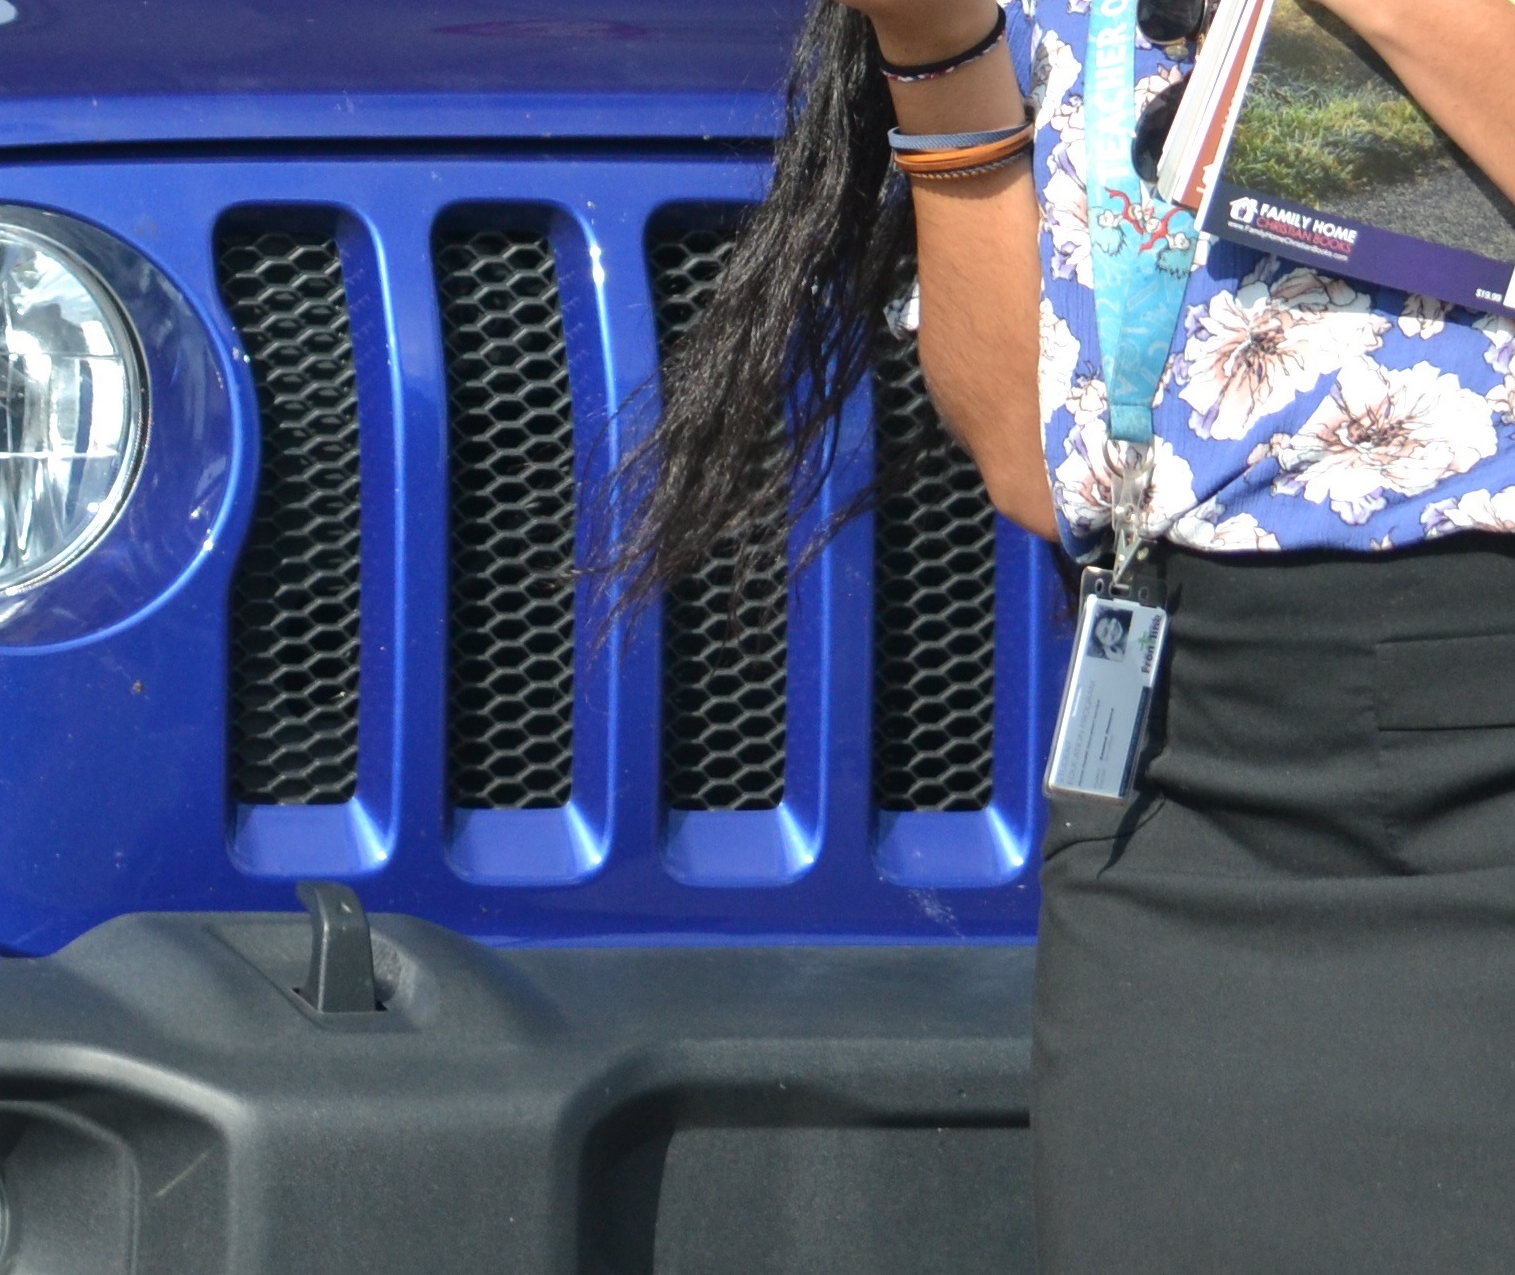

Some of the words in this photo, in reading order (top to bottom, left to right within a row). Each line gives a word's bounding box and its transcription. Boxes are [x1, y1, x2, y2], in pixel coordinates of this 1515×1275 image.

[1096, 22, 1131, 188] TEACHER
[1256, 216, 1313, 244] CHRISTIAN
[1313, 231, 1353, 254] BOOKS
[1259, 203, 1312, 230] FAMILY
[1312, 219, 1358, 244] HOME
